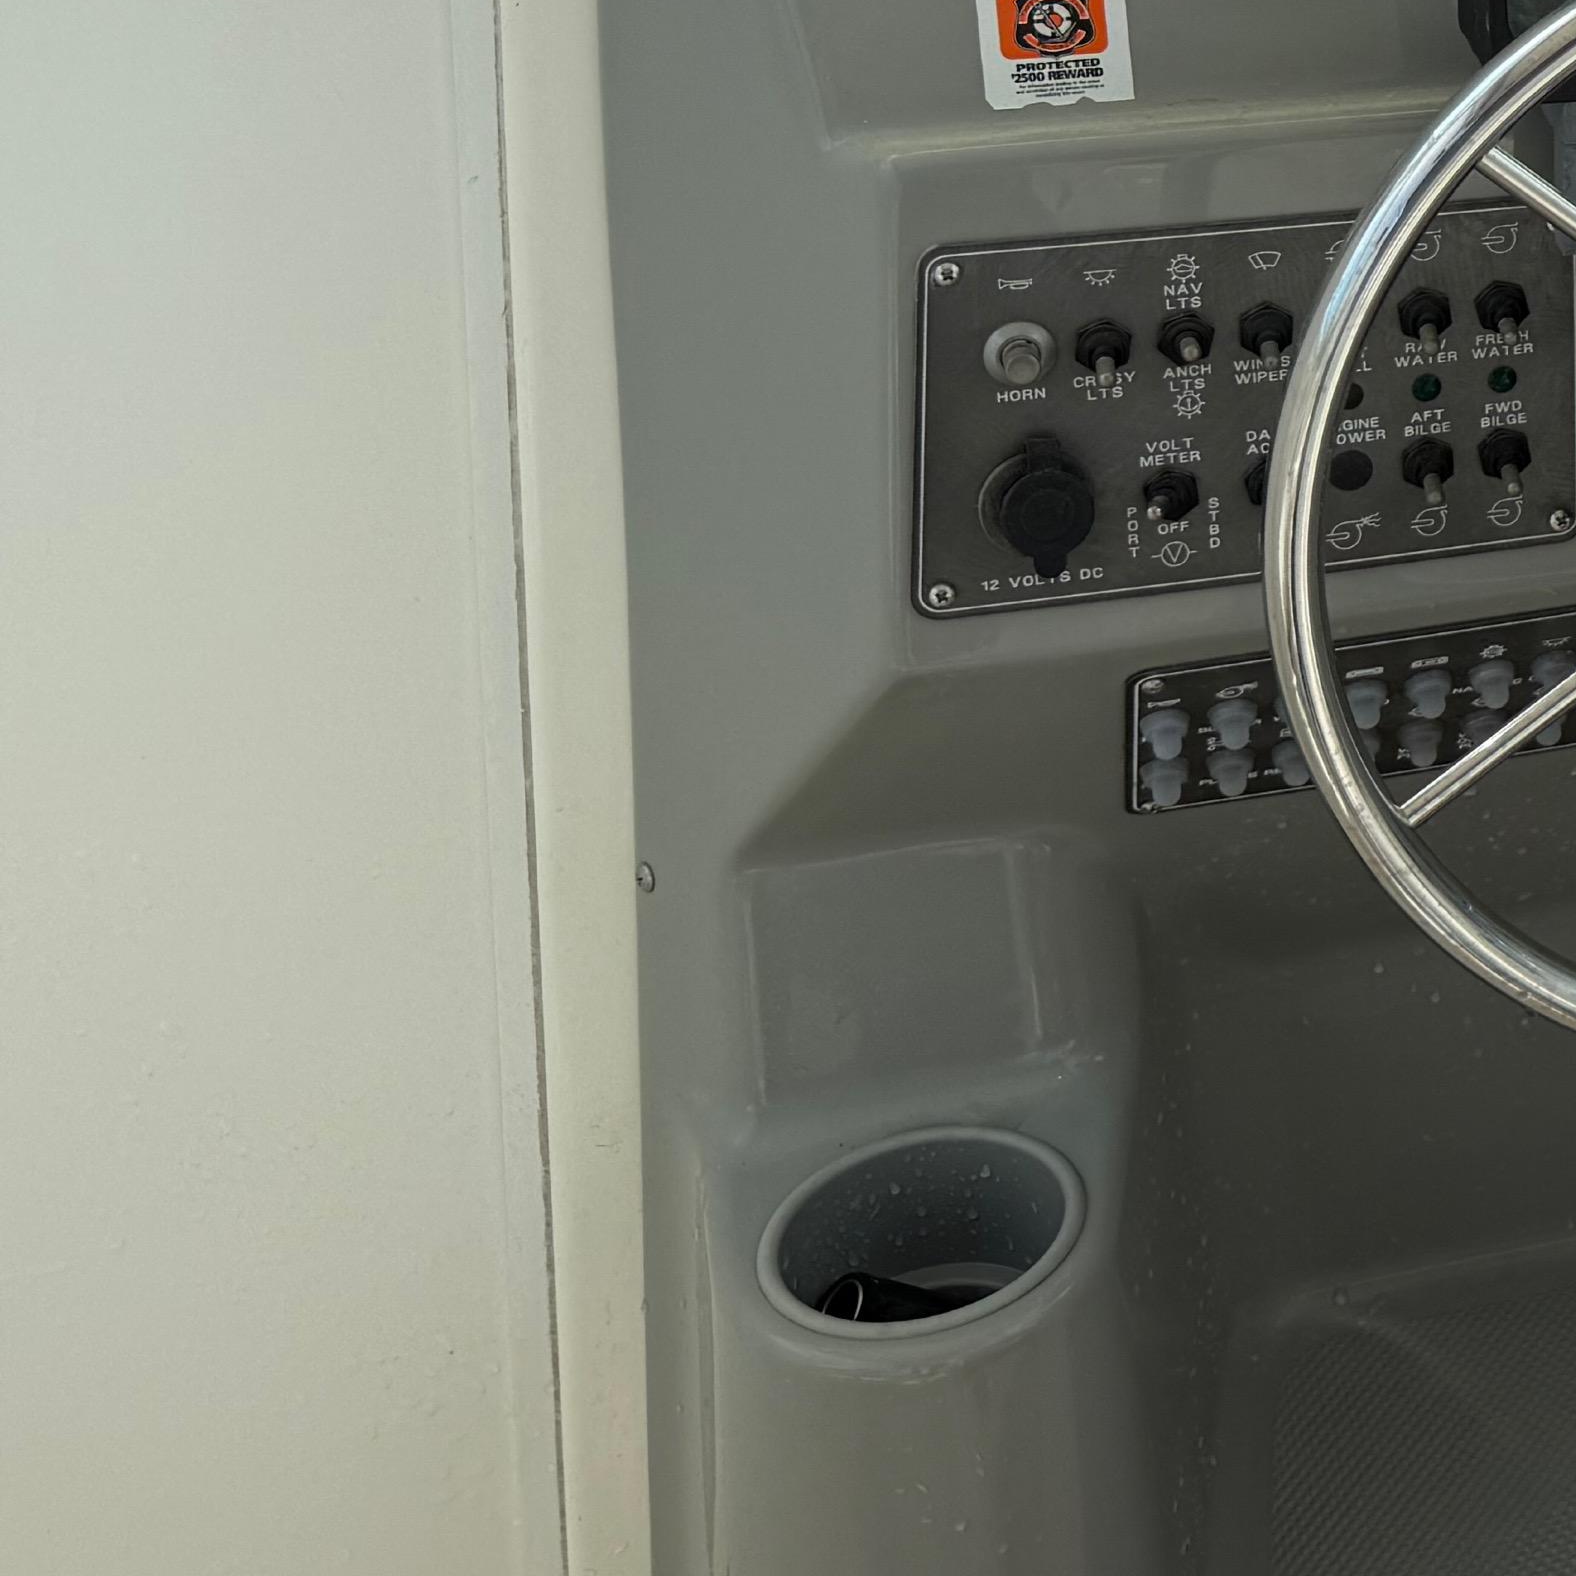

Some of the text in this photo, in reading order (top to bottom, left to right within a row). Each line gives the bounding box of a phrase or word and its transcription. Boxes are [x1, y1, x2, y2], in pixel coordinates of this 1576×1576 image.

[1016, 57, 1100, 72] PROTECTED
[1048, 67, 1104, 81] REWARD
[1163, 282, 1203, 297] NAV
[1166, 296, 1202, 310] LTS
[1472, 343, 1534, 359] WATER
[1163, 363, 1212, 379] ANCH
[1170, 378, 1206, 392] LTS
[997, 387, 1046, 403] HORN
[1087, 386, 1123, 400] LTS
[1485, 400, 1522, 415] FWD
[1411, 408, 1445, 423] AFT
[1481, 412, 1528, 429] BILGE
[1404, 421, 1451, 437] BILGE
[1146, 437, 1194, 452] VOLT
[1140, 450, 1201, 468] METER
[1158, 521, 1190, 535] OFF
[1208, 497, 1221, 548] STBD
[1127, 507, 1140, 558] PORT
[981, 567, 1104, 592] 12 DC
